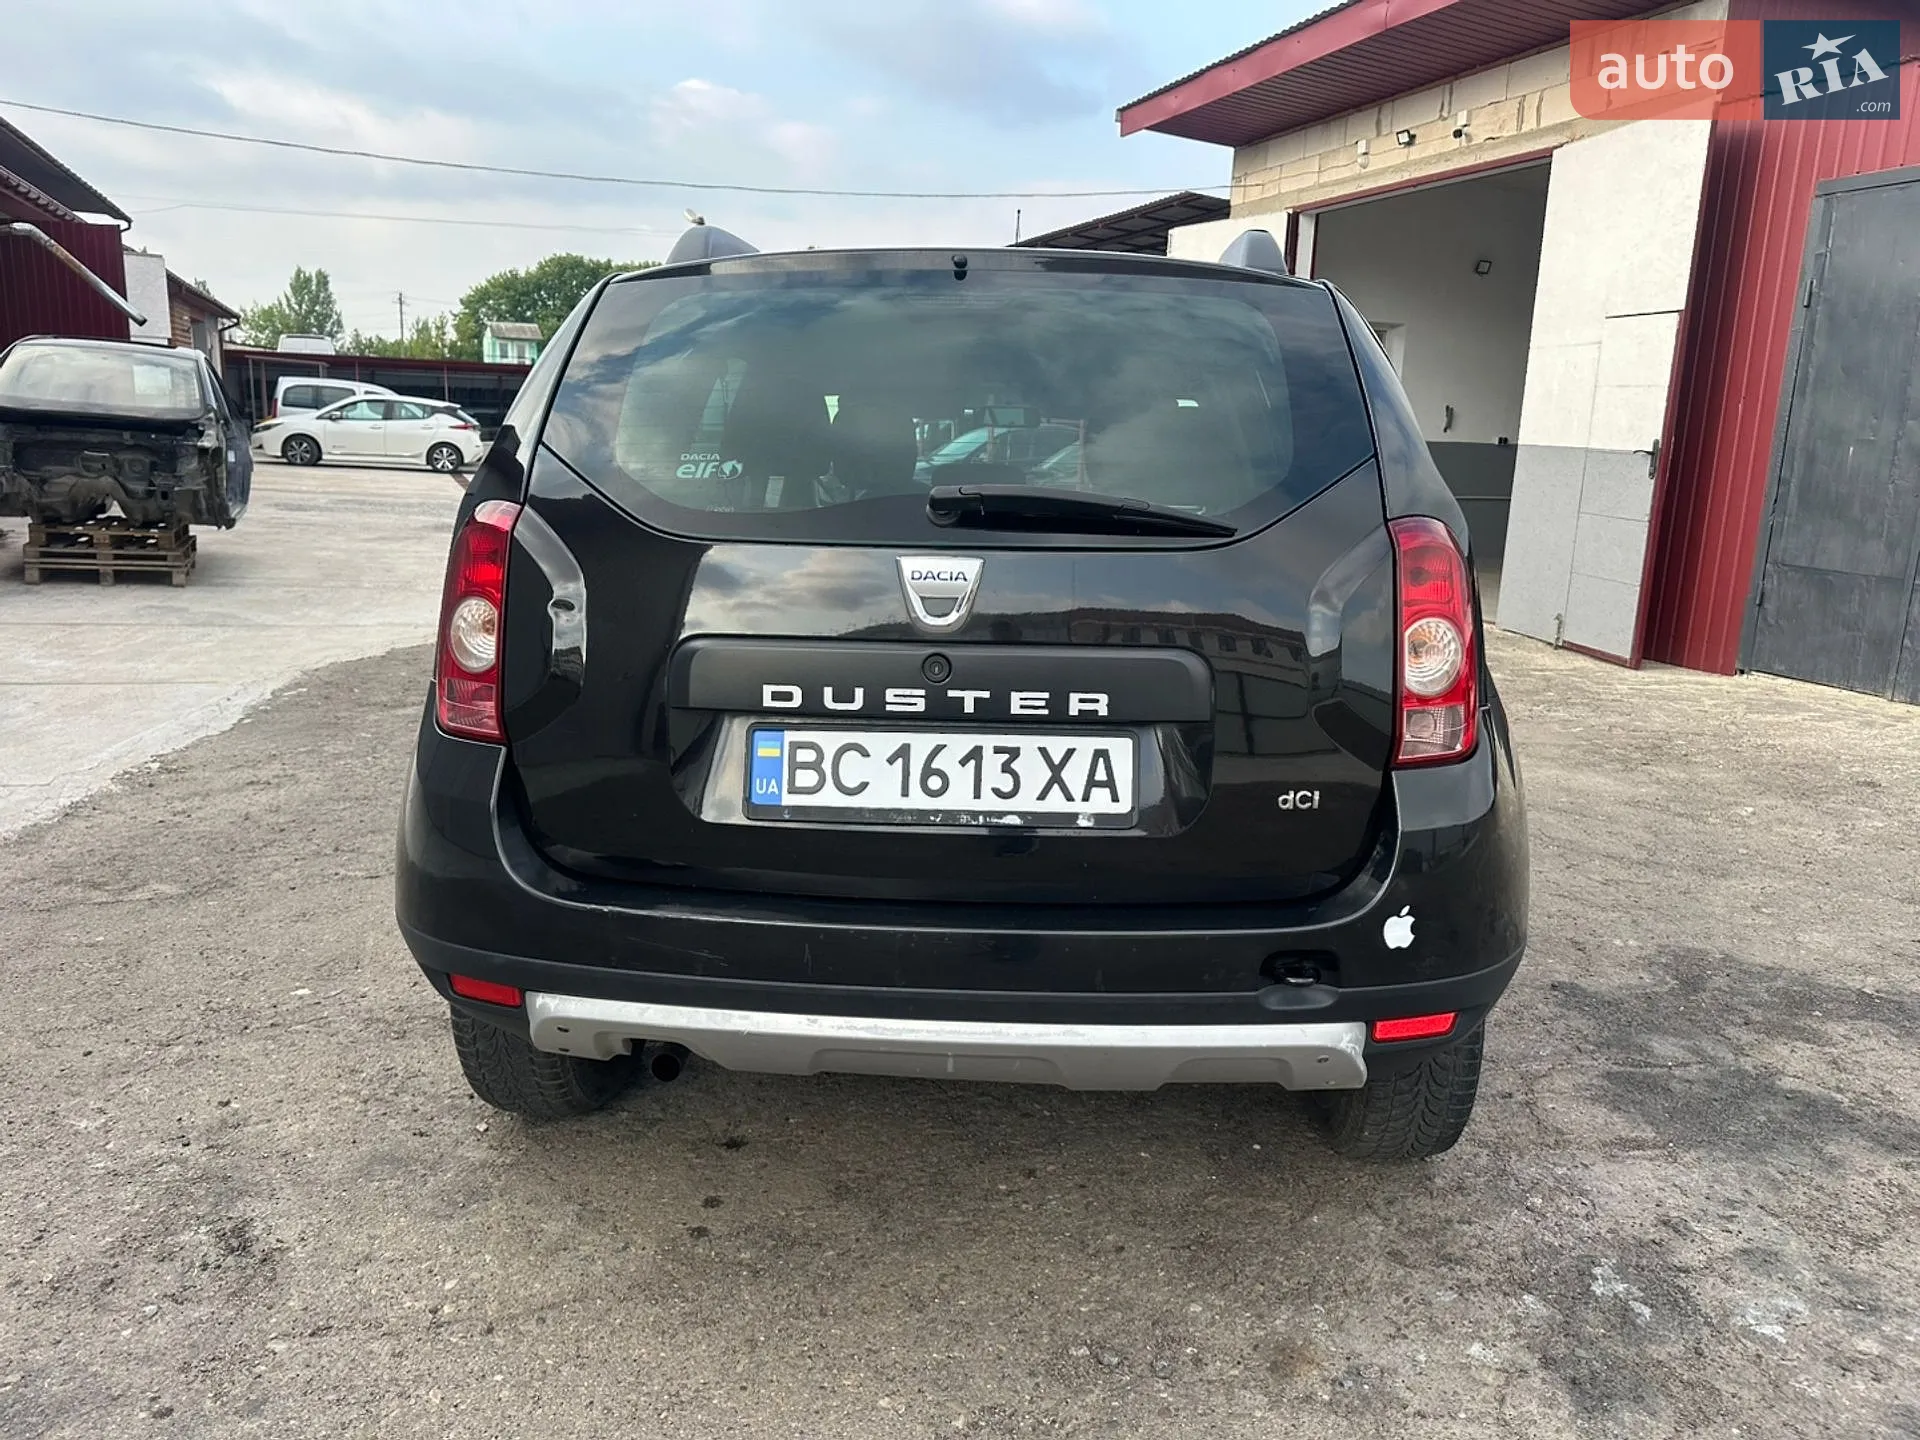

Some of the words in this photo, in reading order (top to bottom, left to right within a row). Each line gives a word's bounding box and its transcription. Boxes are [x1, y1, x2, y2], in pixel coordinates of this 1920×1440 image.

[680, 453, 720, 461] DACIA
[676, 461, 720, 479] elf
[910, 570, 968, 582] DACIA
[762, 684, 1109, 716] DUSTER
[787, 741, 870, 796] BC
[886, 743, 1021, 800] 1613
[1036, 747, 1120, 803] XA
[755, 778, 779, 795] UA
